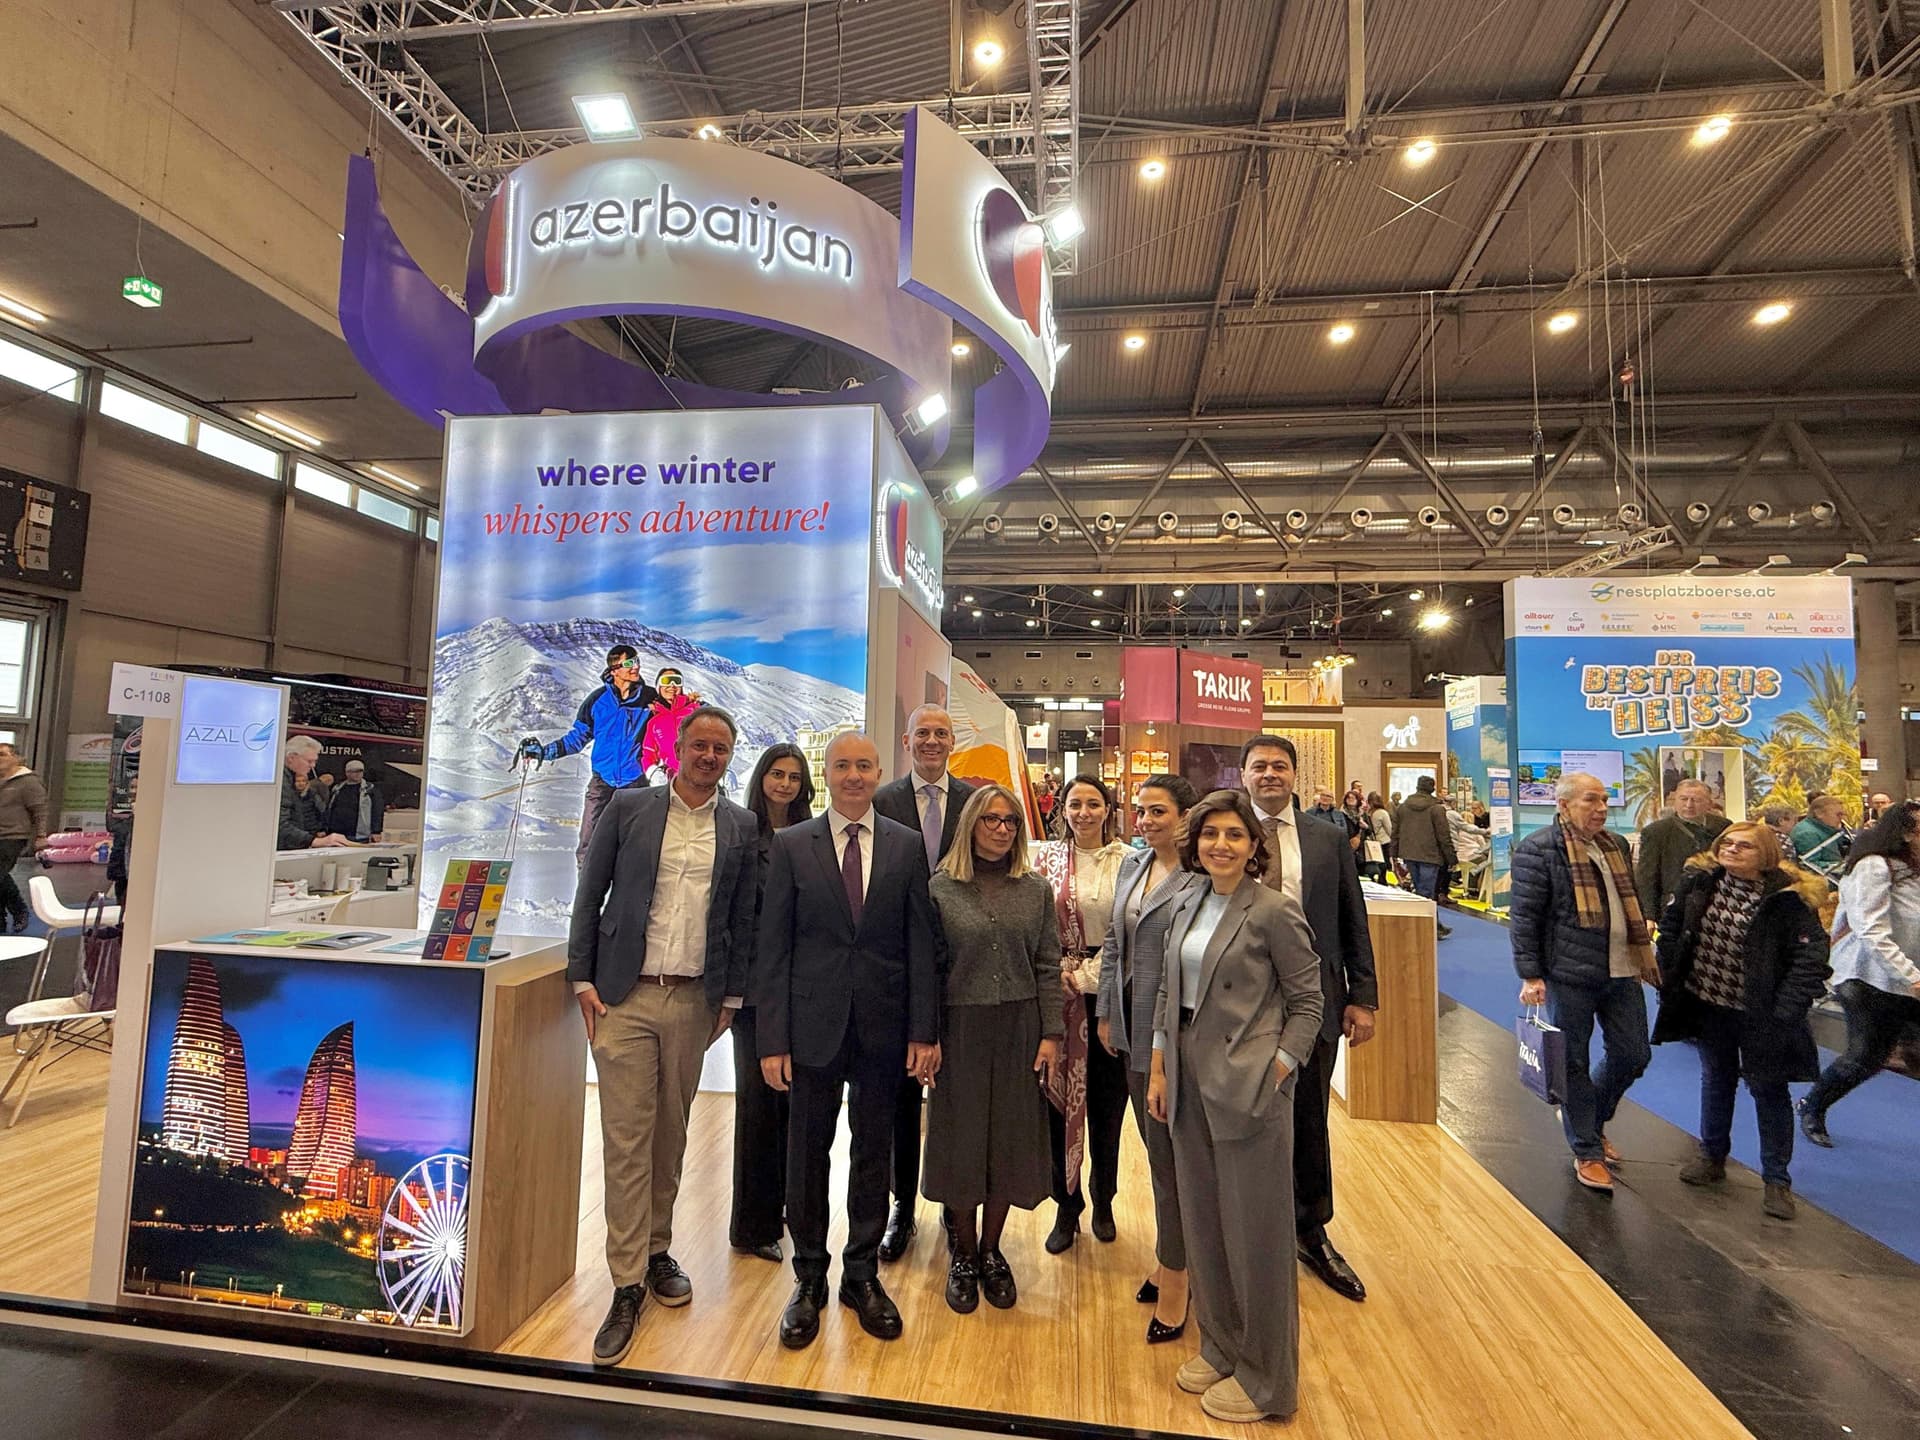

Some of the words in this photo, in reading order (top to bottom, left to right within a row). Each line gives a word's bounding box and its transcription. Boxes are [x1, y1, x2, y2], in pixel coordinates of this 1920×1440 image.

[529, 183, 852, 278] azerbaijan
[537, 458, 647, 486] where
[659, 454, 776, 485] winter
[483, 503, 632, 543] whispers
[640, 500, 831, 535] adventure!
[1616, 585, 1776, 600] restplatzboerse.at
[1524, 612, 1555, 620] alltours
[1767, 612, 1794, 621] AIDA
[1657, 652, 1693, 666] DER
[1192, 669, 1252, 703] TARUK
[1583, 667, 1779, 697] BESTPREIS
[123, 688, 171, 704] C-1108
[1589, 696, 1615, 708] IST
[1614, 692, 1749, 735] HEISS
[185, 727, 241, 743] AZAL
[319, 745, 362, 756] USTRIA
